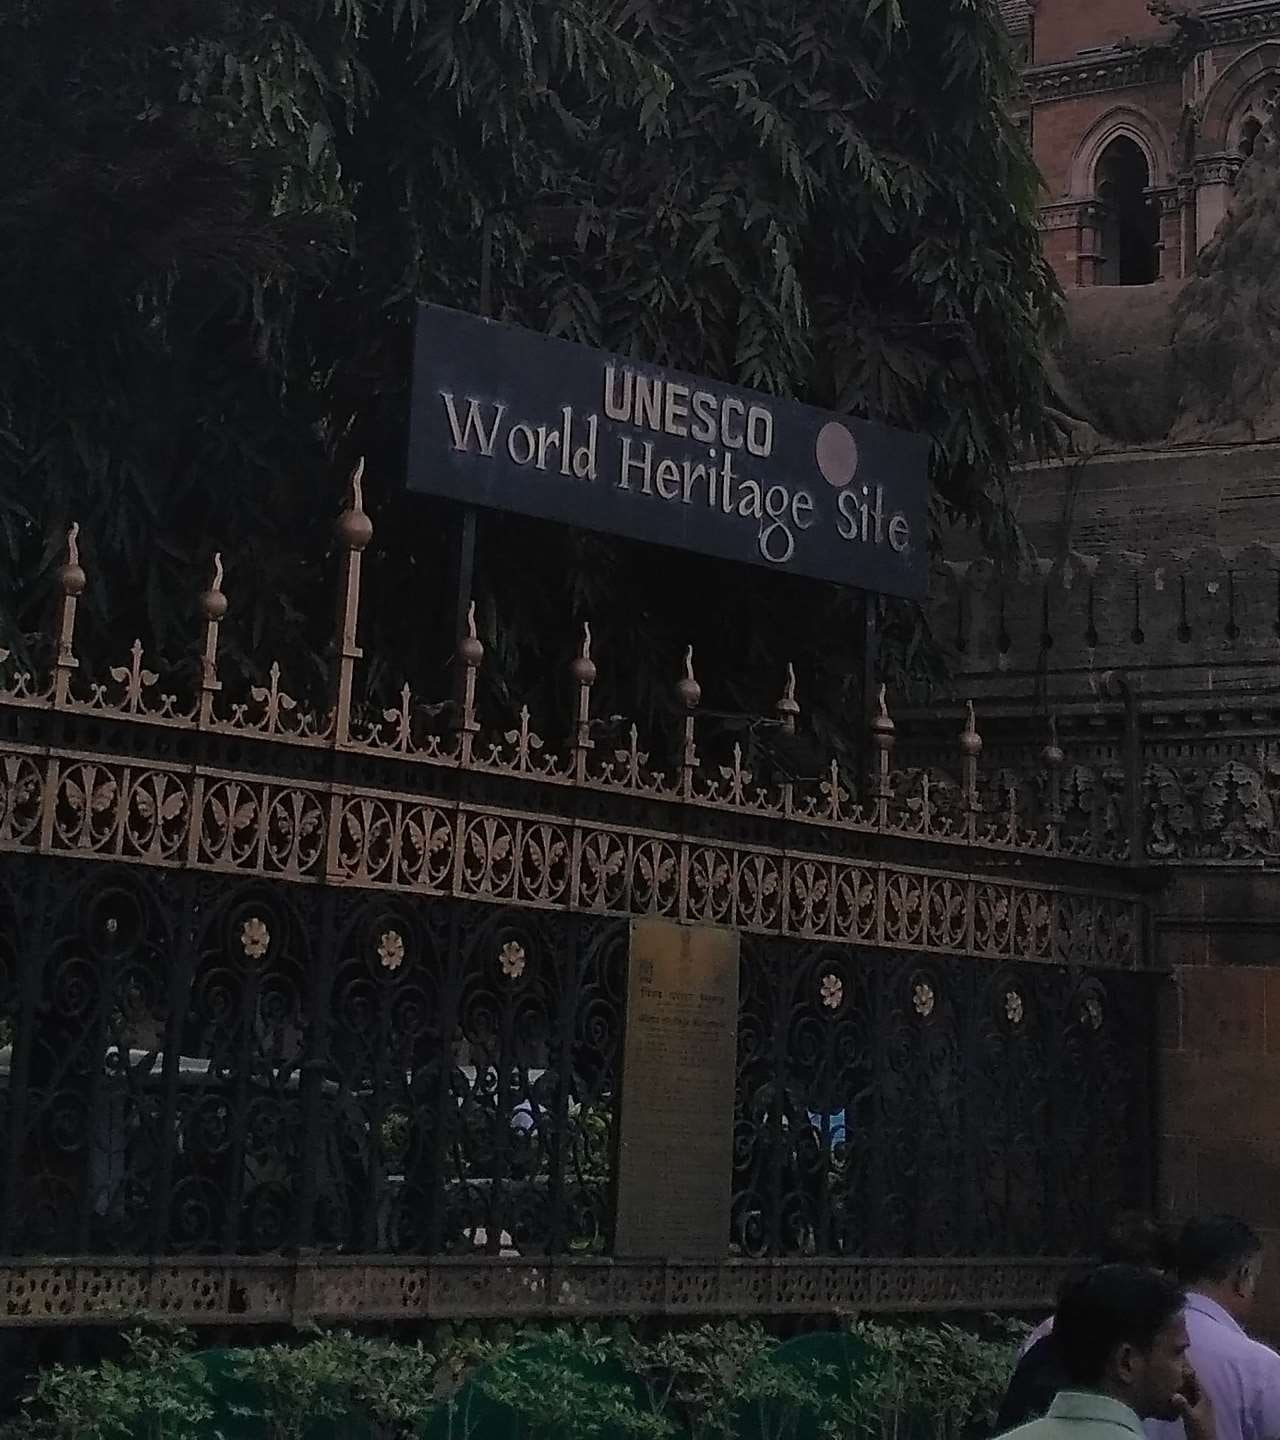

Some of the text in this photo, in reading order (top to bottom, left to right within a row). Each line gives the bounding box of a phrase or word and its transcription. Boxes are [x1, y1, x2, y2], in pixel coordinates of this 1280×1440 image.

[439, 390, 911, 563] World Heritage Site
[603, 361, 774, 458] UNESCO
